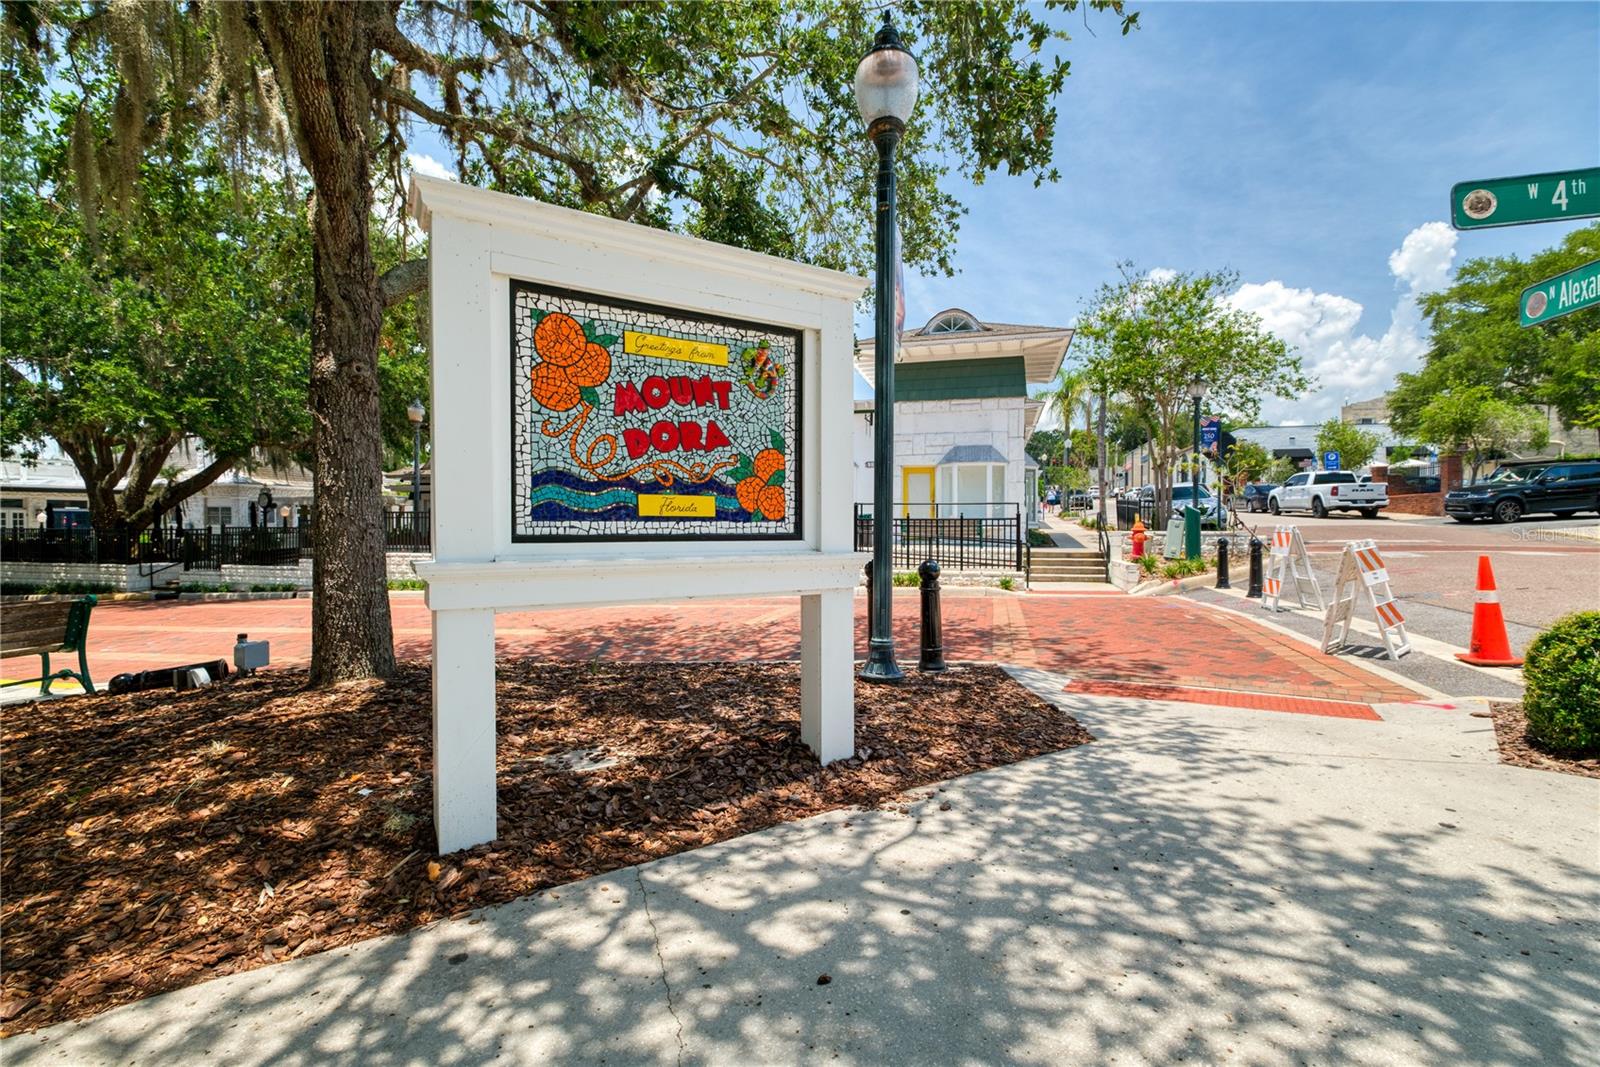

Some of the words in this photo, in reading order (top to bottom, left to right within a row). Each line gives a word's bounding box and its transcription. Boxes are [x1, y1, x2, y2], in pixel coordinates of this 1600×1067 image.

[1528, 183, 1538, 199] W
[1551, 179, 1586, 211] 4th
[1549, 285, 1556, 300] N
[634, 335, 682, 356] Greetings
[688, 347, 715, 361] from
[614, 375, 732, 416] MOUNT
[622, 420, 731, 460] DORA
[659, 496, 698, 515] Florida
